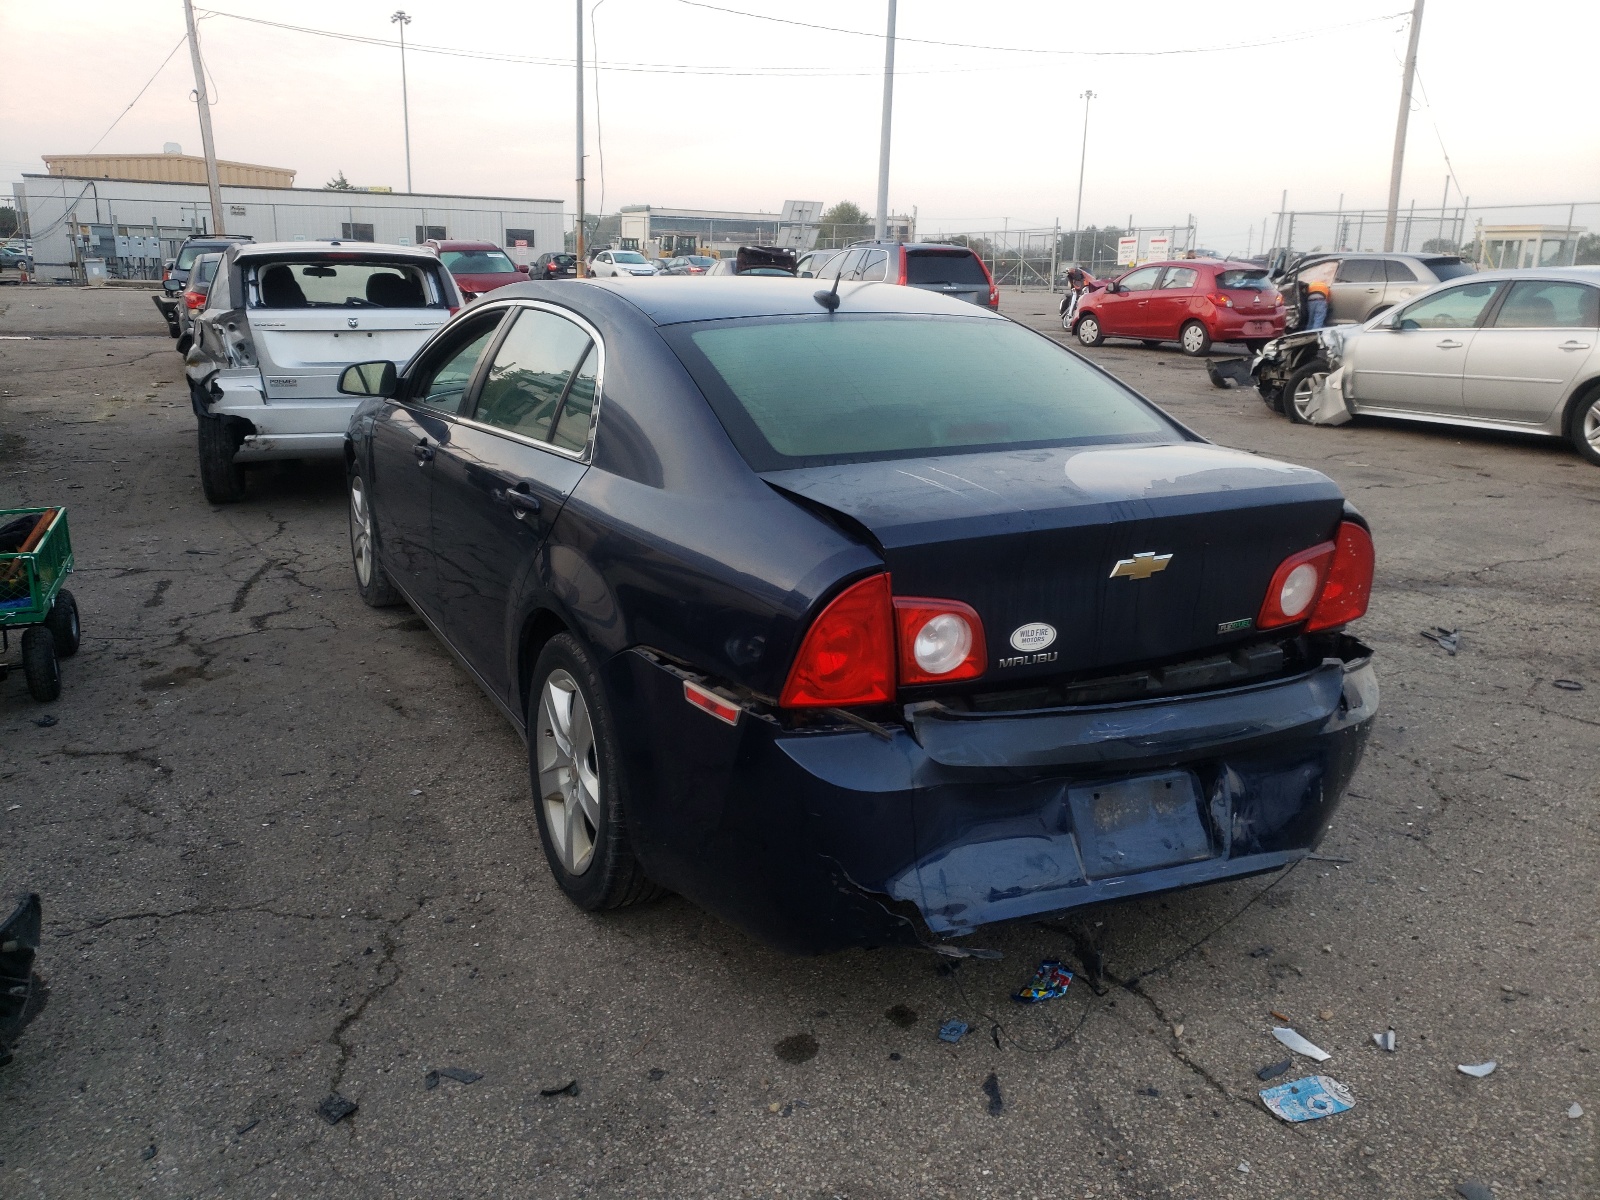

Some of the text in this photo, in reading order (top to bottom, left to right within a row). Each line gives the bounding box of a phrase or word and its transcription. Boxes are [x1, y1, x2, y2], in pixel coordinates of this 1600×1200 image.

[1020, 628, 1049, 638] WILD FIRE
[1021, 636, 1045, 644] MOTORS
[999, 651, 1059, 668] MALIBU
